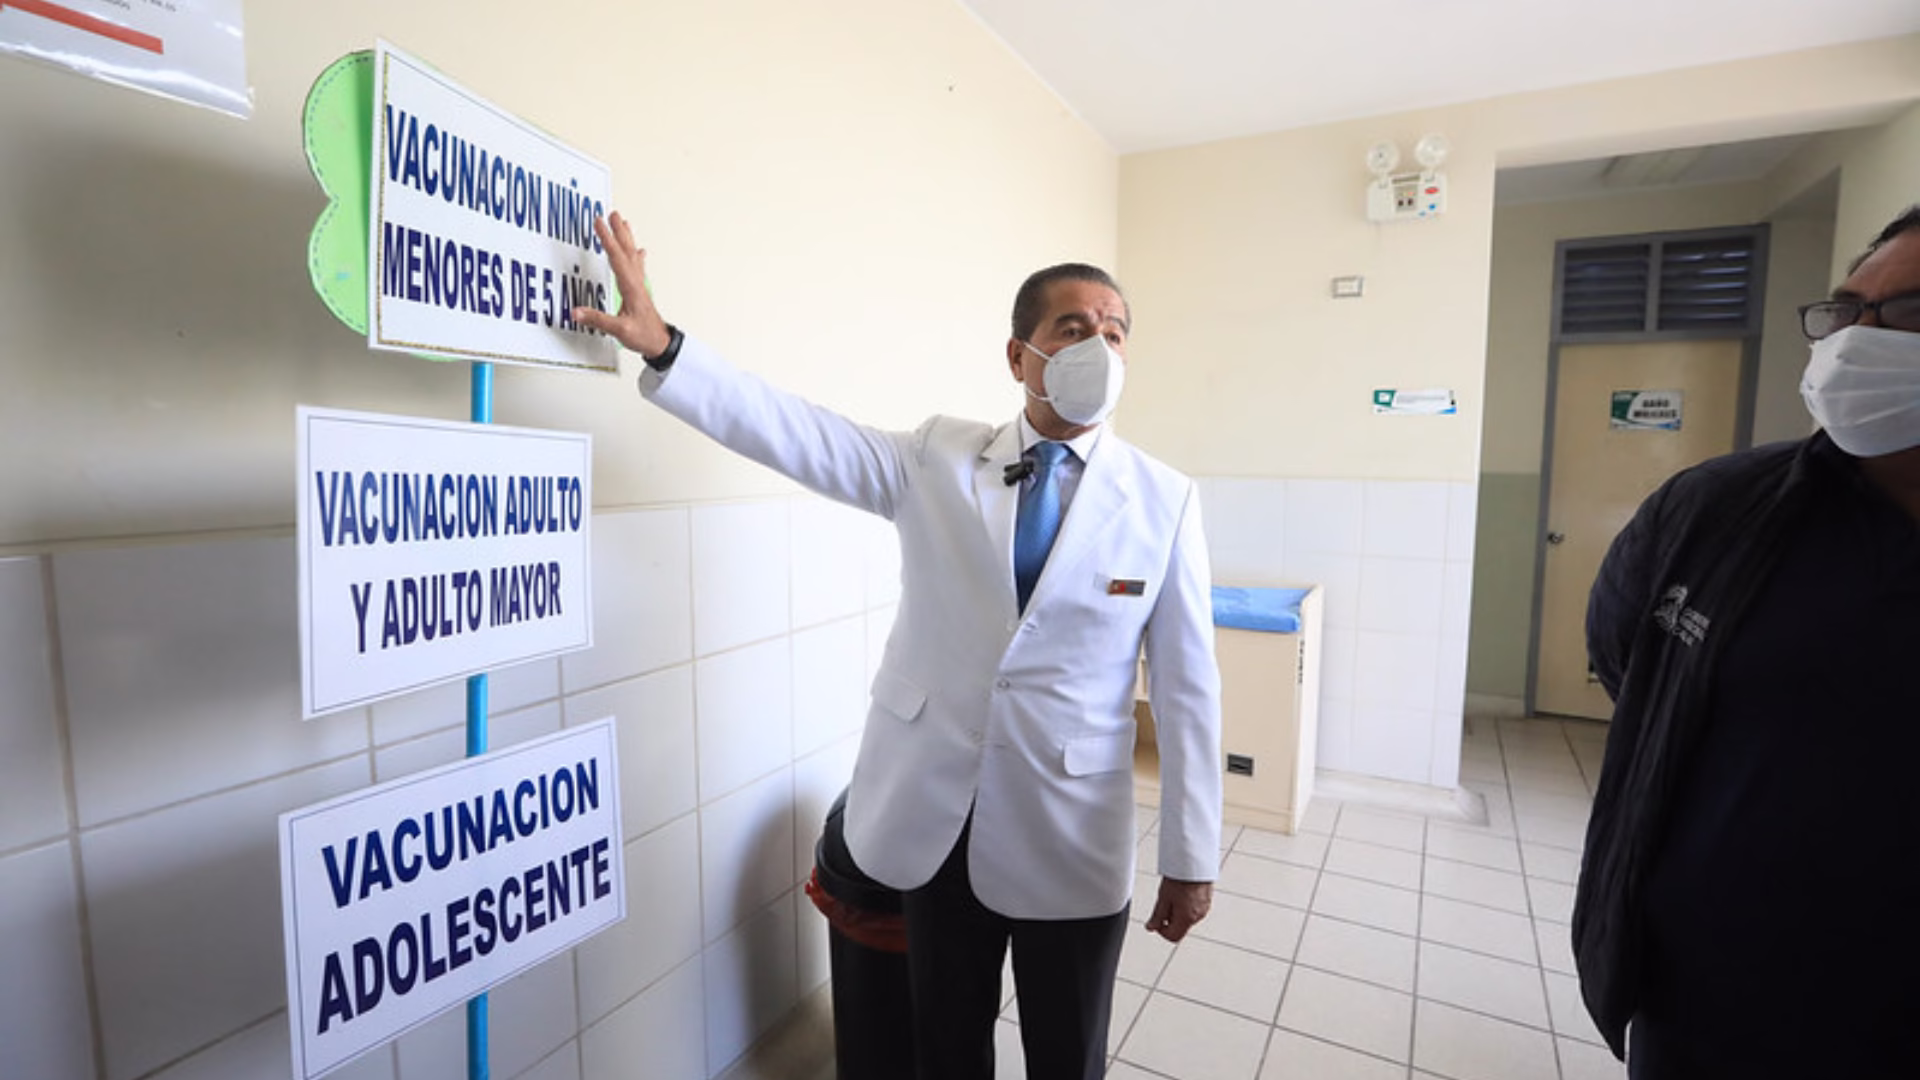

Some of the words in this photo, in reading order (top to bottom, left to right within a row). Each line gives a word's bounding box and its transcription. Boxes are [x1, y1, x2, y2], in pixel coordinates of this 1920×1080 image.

[386, 104, 541, 233] VACUNACION
[548, 178, 604, 254] NIÑOS
[384, 221, 503, 318] MENORES
[511, 259, 538, 323] DE
[543, 268, 554, 328] 5
[560, 265, 606, 337] AÑOS
[316, 471, 498, 547] VACUNACION
[504, 476, 582, 535] ADULTO
[350, 582, 372, 654] Y
[381, 569, 483, 649] ADULTO
[490, 562, 562, 628] MAYOR
[321, 757, 599, 909] VACUNACION
[316, 837, 611, 1036] ADOLESCENTE
